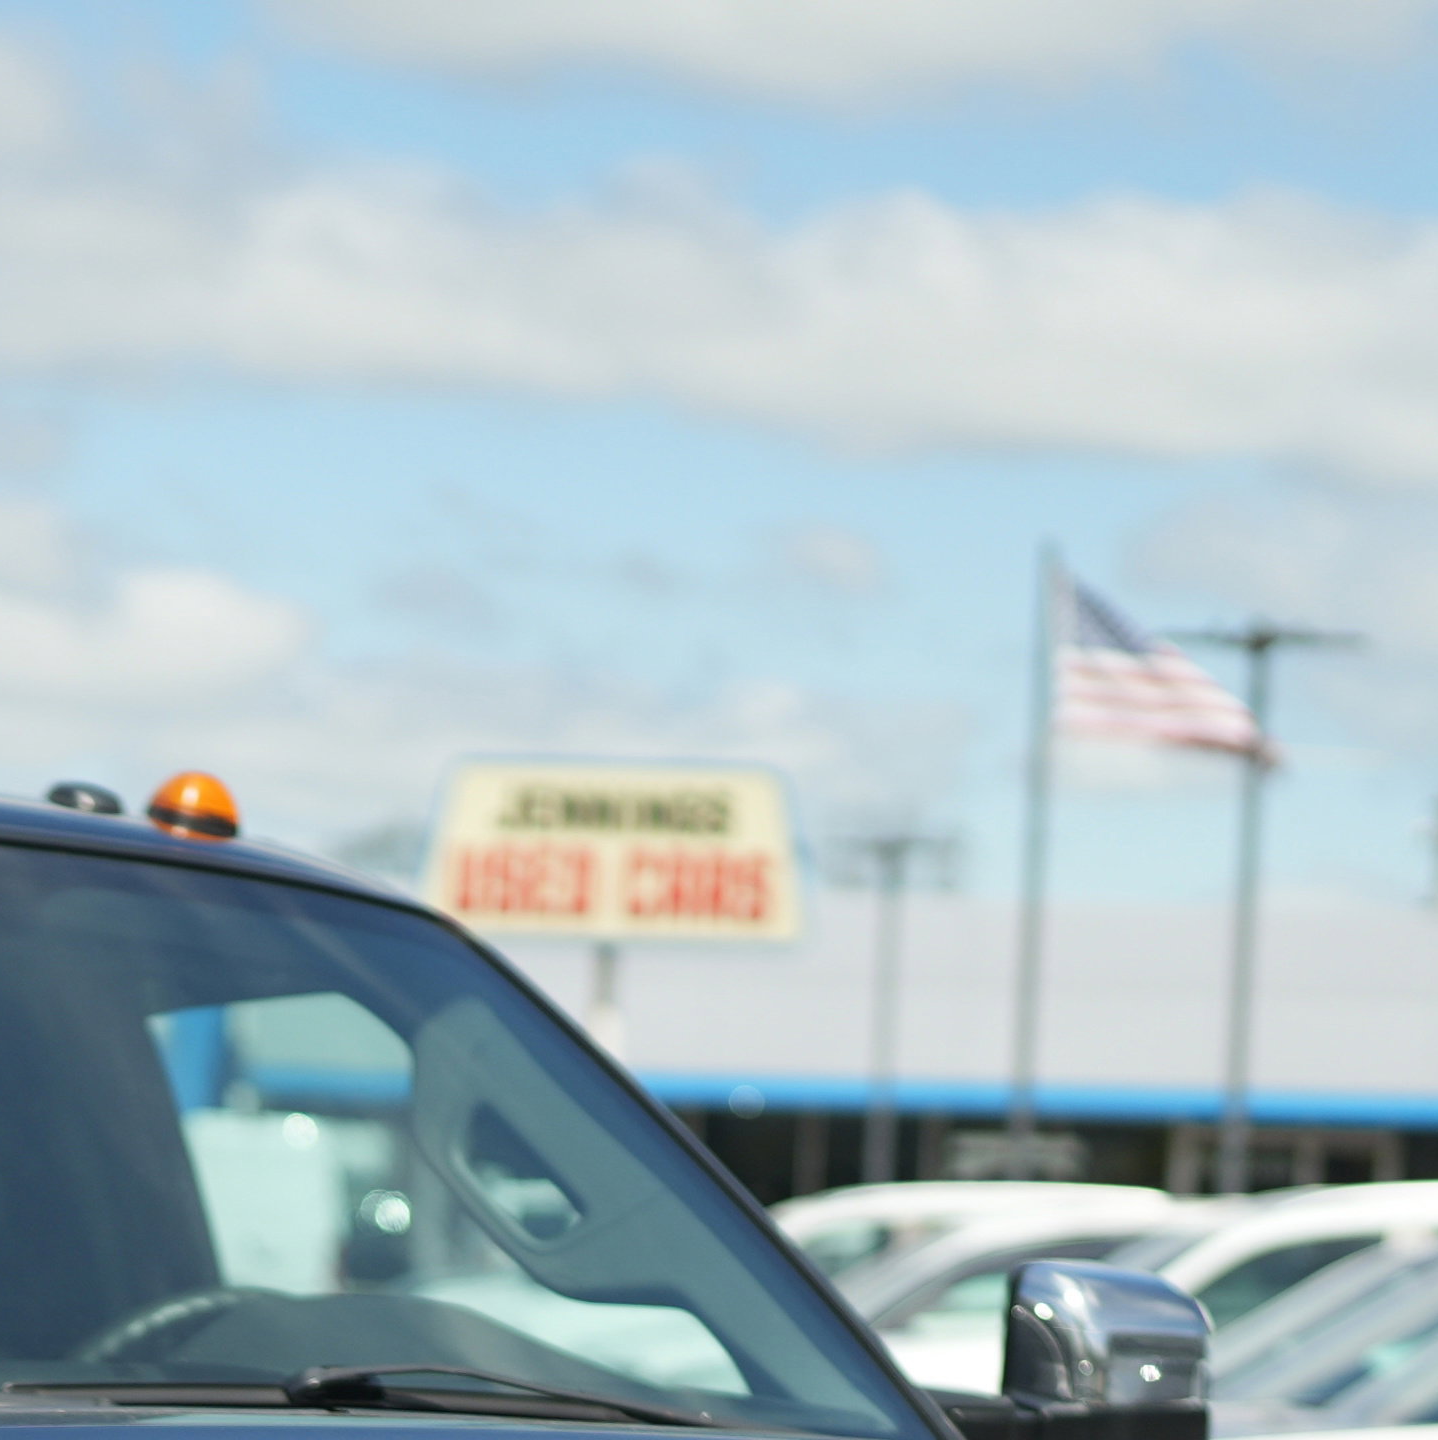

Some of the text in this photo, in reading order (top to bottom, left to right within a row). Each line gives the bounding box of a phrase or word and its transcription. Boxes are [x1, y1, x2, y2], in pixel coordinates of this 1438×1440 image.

[502, 787, 730, 833] JENNINGS
[452, 847, 768, 920] USED CARS
